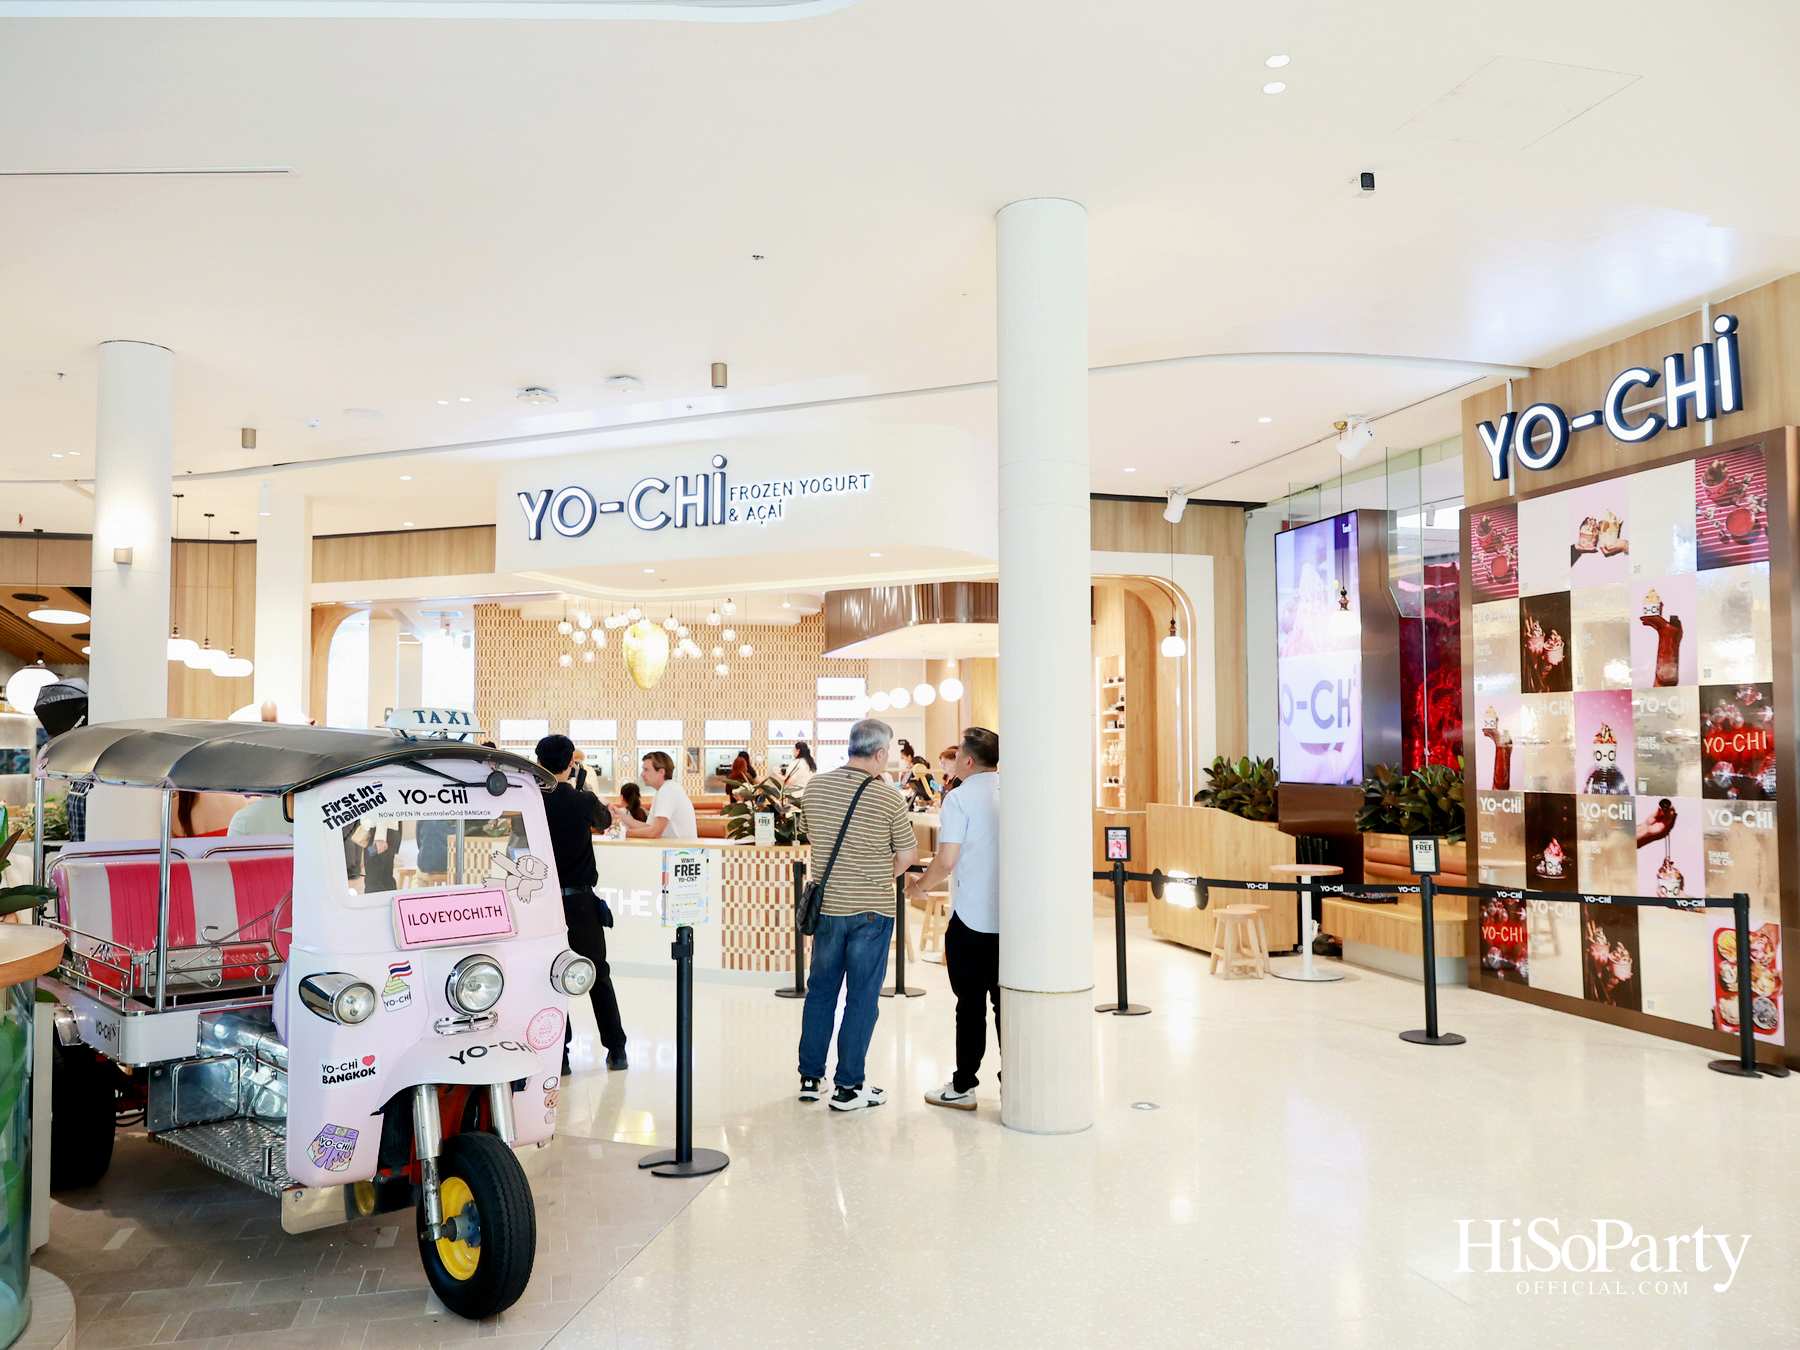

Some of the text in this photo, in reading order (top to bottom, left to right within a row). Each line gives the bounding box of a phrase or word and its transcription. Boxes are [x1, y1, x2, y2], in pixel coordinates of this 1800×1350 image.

[729, 474, 871, 502] FROZEN YOGURT
[728, 499, 782, 526] & AÇAÍ
[412, 710, 471, 726] TAXI
[1703, 731, 1768, 753] YO-CHI
[321, 785, 375, 817] First In
[322, 792, 388, 831] Thailand
[674, 863, 701, 877] FREE
[598, 887, 653, 917] THE
[407, 905, 503, 926] ILOVEYOCHI.TH
[1482, 926, 1523, 943] YO-CHI
[322, 1066, 376, 1085] BANGKOK
